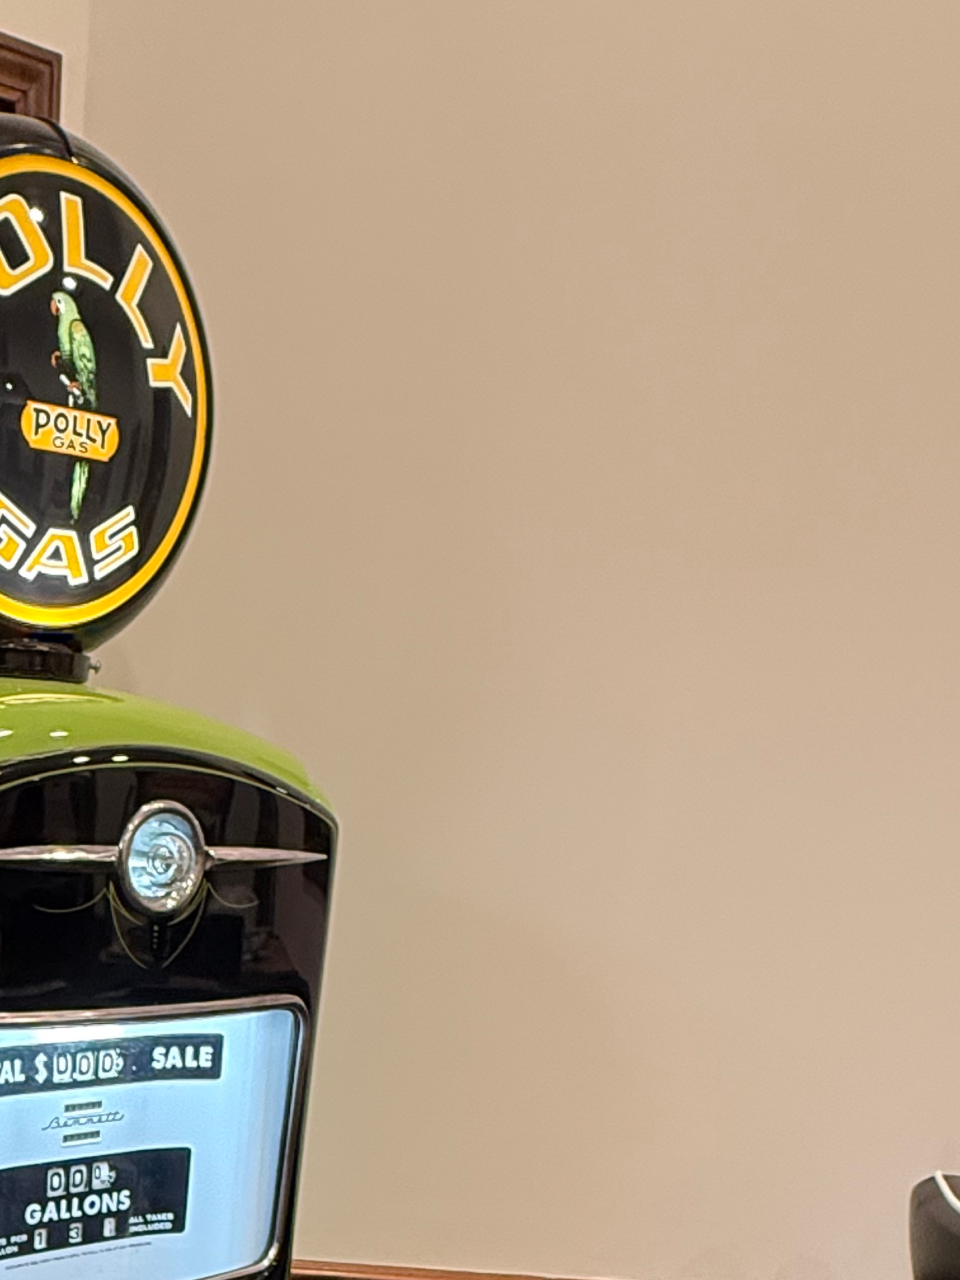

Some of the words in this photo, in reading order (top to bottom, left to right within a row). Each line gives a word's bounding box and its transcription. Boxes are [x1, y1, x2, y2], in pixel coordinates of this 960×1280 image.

[33, 407, 112, 450] POLLY
[52, 435, 88, 454] GAS
[151, 1045, 213, 1070] SALE
[25, 1190, 131, 1225] GALLONS
